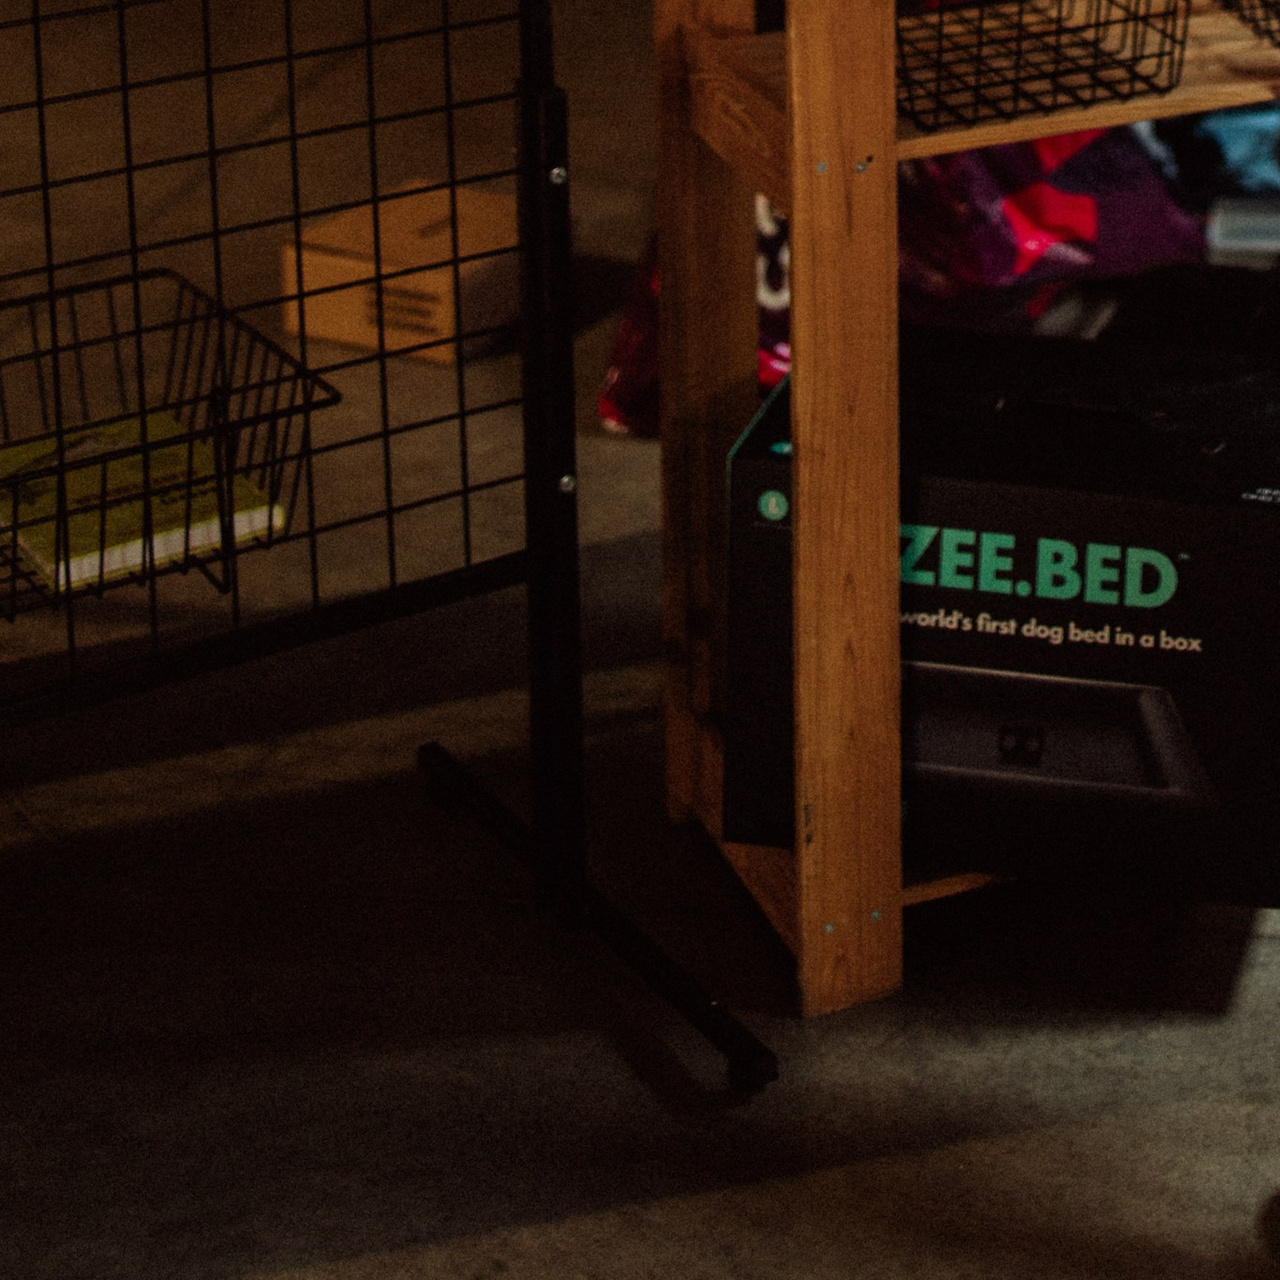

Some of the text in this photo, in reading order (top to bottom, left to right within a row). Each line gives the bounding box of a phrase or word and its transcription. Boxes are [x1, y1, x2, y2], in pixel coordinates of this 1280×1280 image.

[900, 523, 1179, 609] ZEE.BED
[976, 612, 1018, 636] first
[1021, 618, 1064, 645] dog
[1068, 622, 1111, 643] bed
[1114, 626, 1135, 646] in
[1139, 634, 1155, 648] a
[1159, 630, 1202, 652] box
